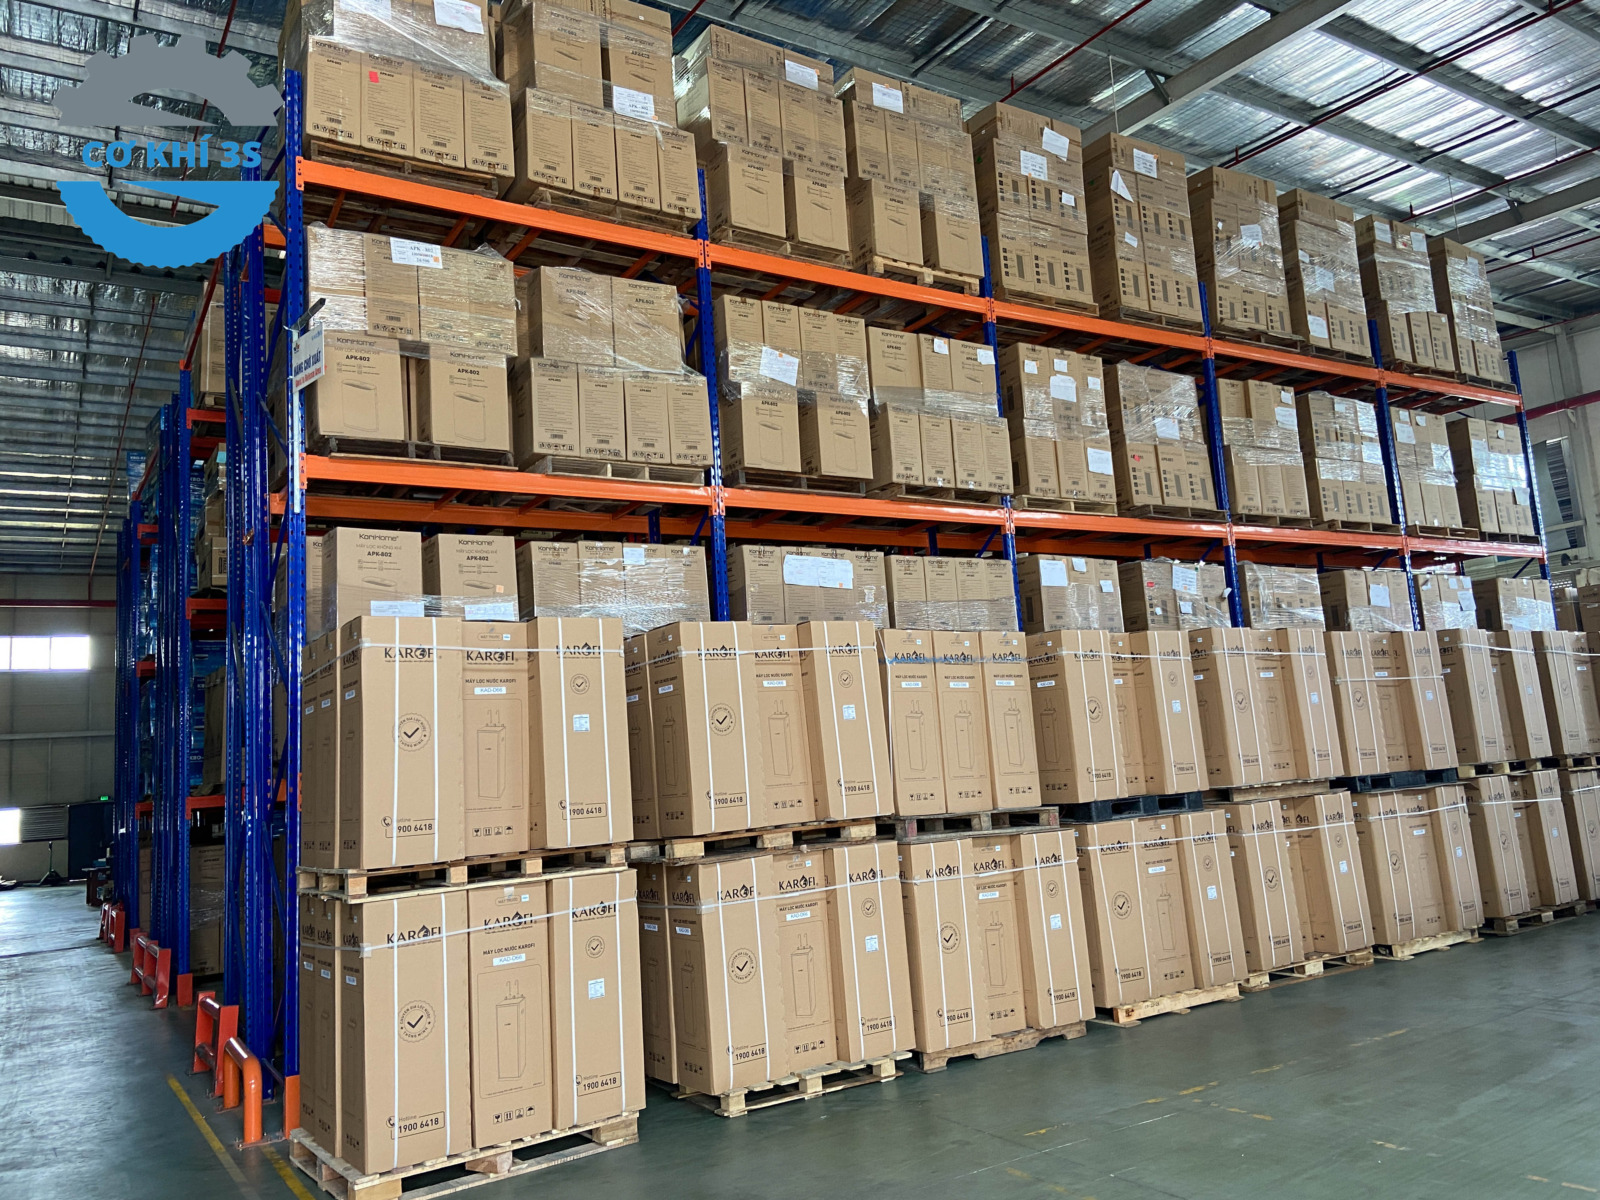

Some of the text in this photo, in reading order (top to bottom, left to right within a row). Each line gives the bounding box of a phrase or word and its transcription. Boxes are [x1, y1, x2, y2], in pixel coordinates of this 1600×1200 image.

[384, 644, 437, 660] KAROF
[466, 648, 515, 662] KAROFI
[729, 796, 743, 804] 6418
[414, 823, 432, 832] 6418
[926, 864, 959, 878] KAROFI
[974, 858, 1004, 872] KAROFI
[849, 867, 884, 883] KAROFI
[779, 875, 816, 890] KAROFI
[717, 884, 755, 901] KAROF
[572, 901, 616, 918] KAROFI
[484, 911, 533, 930] KAROFI
[386, 925, 442, 944] KAROFI
[499, 955, 522, 963] KAD-D66
[957, 1012, 969, 1020] 6418
[866, 1020, 893, 1031] 1900 6418
[735, 1047, 765, 1060] 1900 6418
[583, 1077, 616, 1091] 1900 6418
[398, 1118, 439, 1133] 1900 6418
